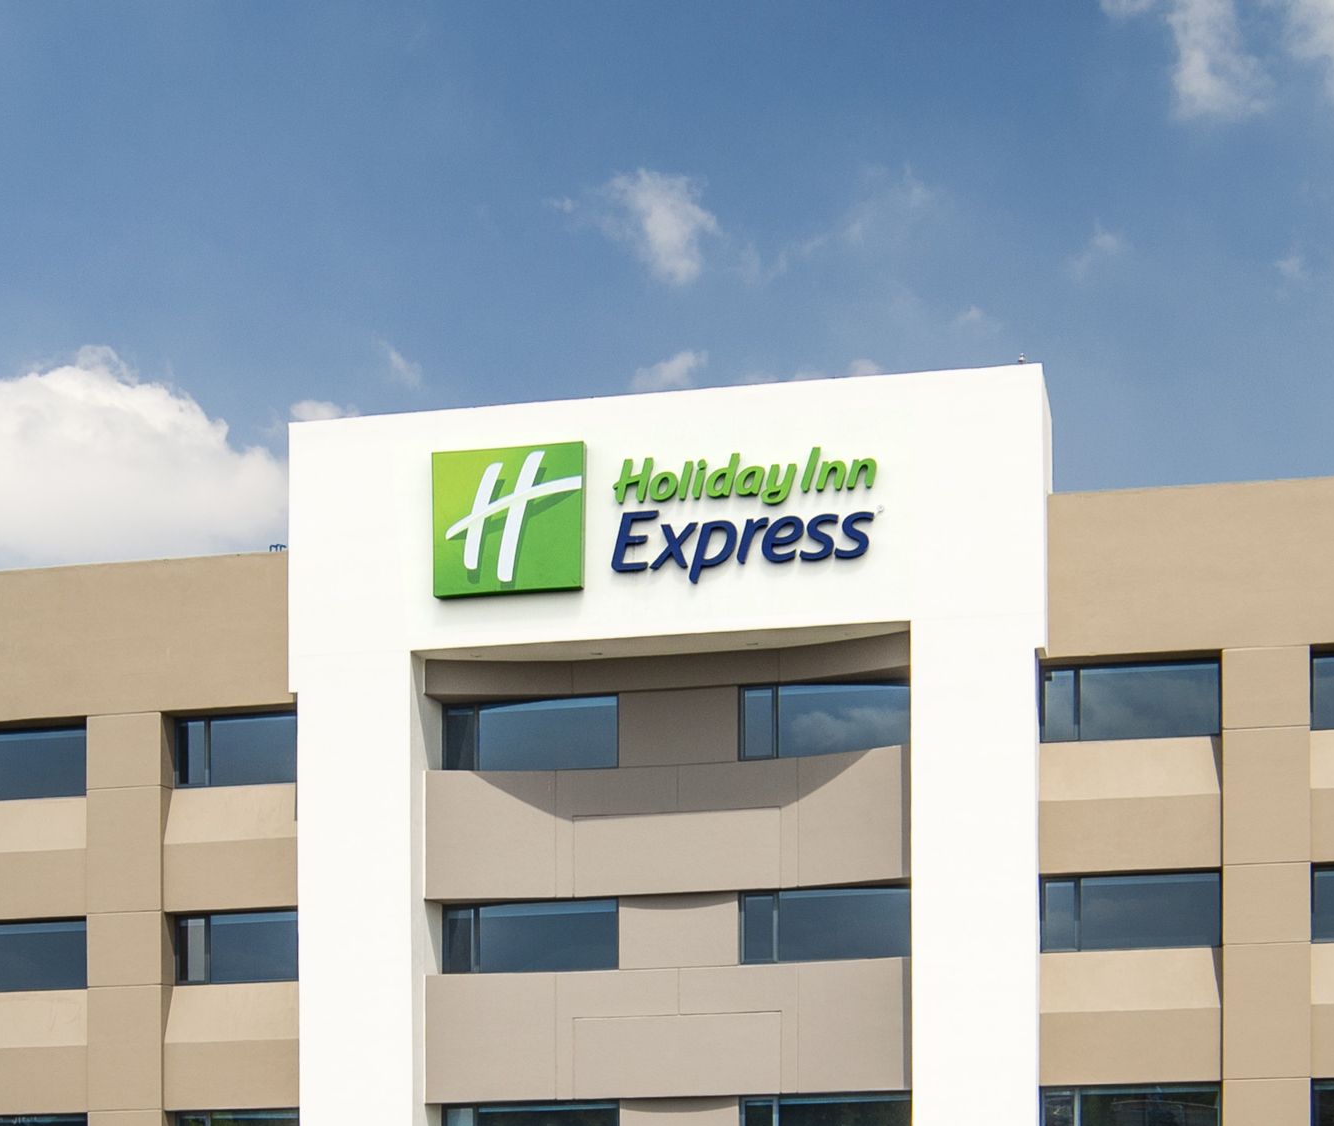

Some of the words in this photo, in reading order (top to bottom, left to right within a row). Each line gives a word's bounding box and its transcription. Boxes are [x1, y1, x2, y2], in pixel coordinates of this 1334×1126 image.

[612, 452, 797, 505] Holiday
[800, 446, 877, 493] Inn
[611, 509, 875, 585] Express
